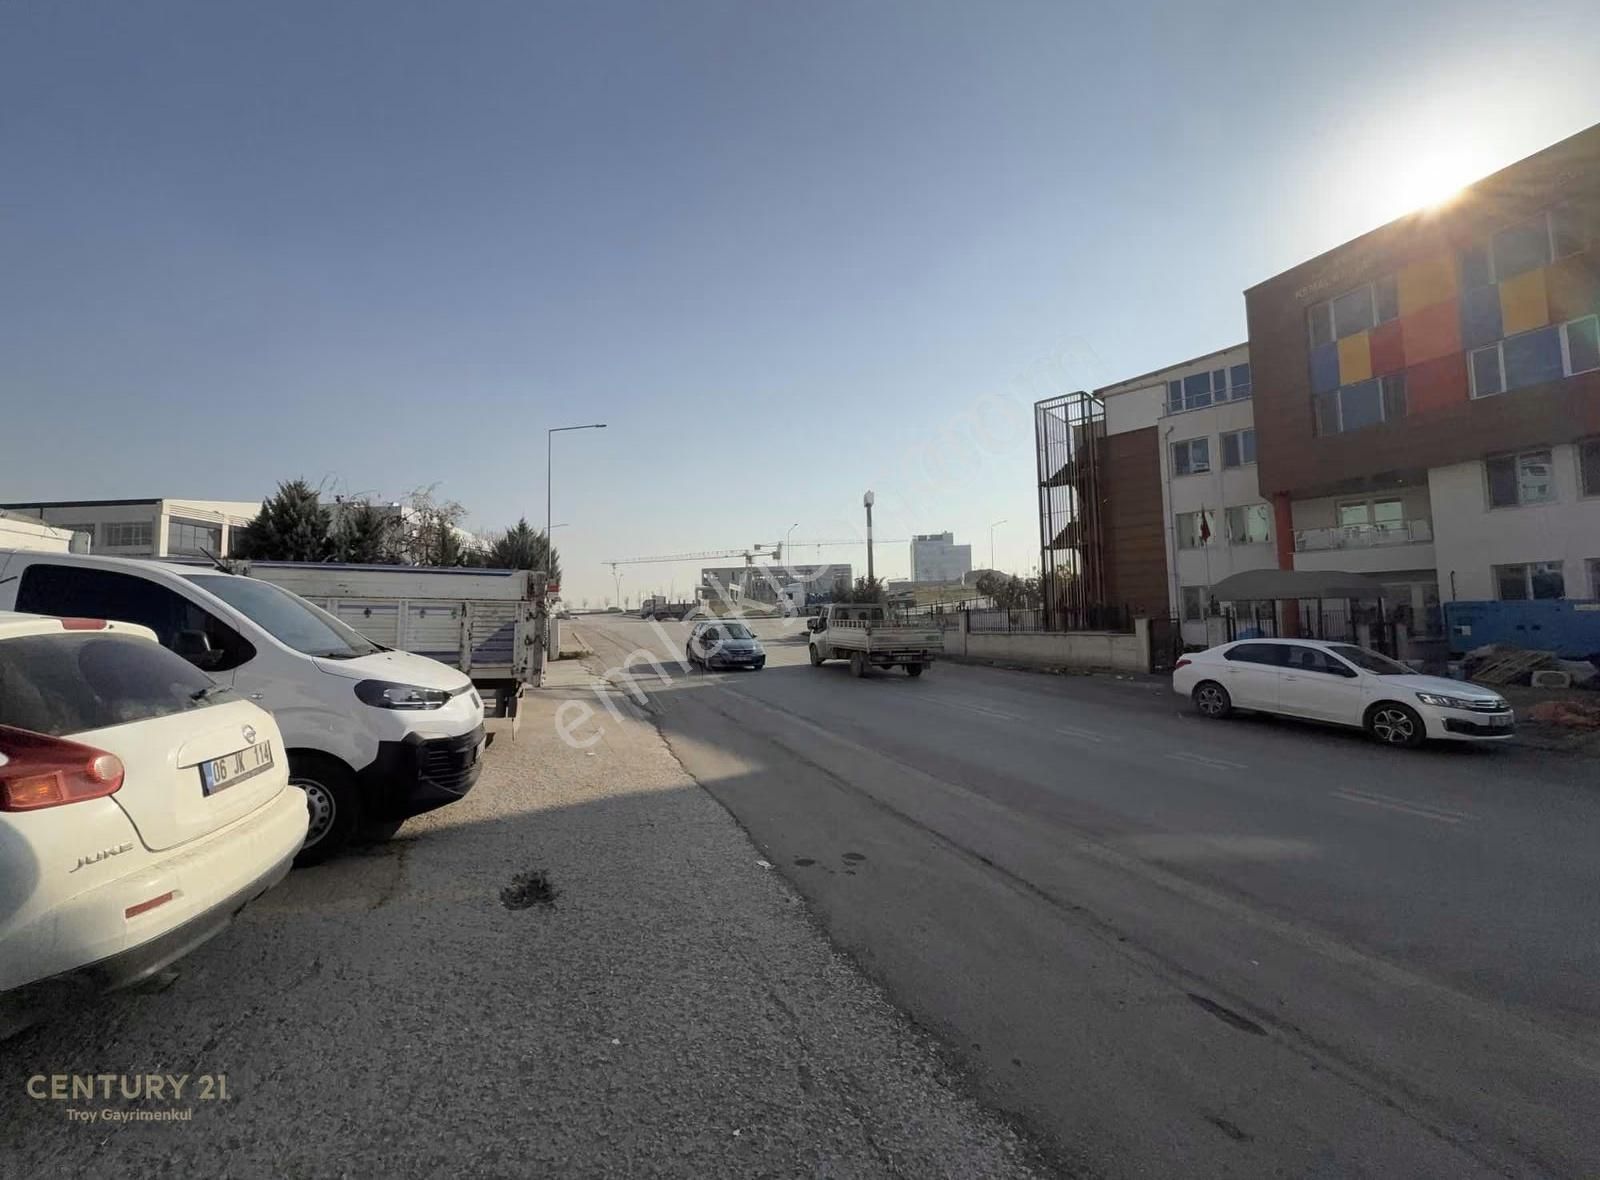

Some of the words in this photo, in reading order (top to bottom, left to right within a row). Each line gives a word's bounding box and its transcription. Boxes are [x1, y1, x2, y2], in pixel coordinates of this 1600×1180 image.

[213, 759, 227, 782] 06
[234, 752, 245, 774] JK
[69, 841, 135, 873] JUKE
